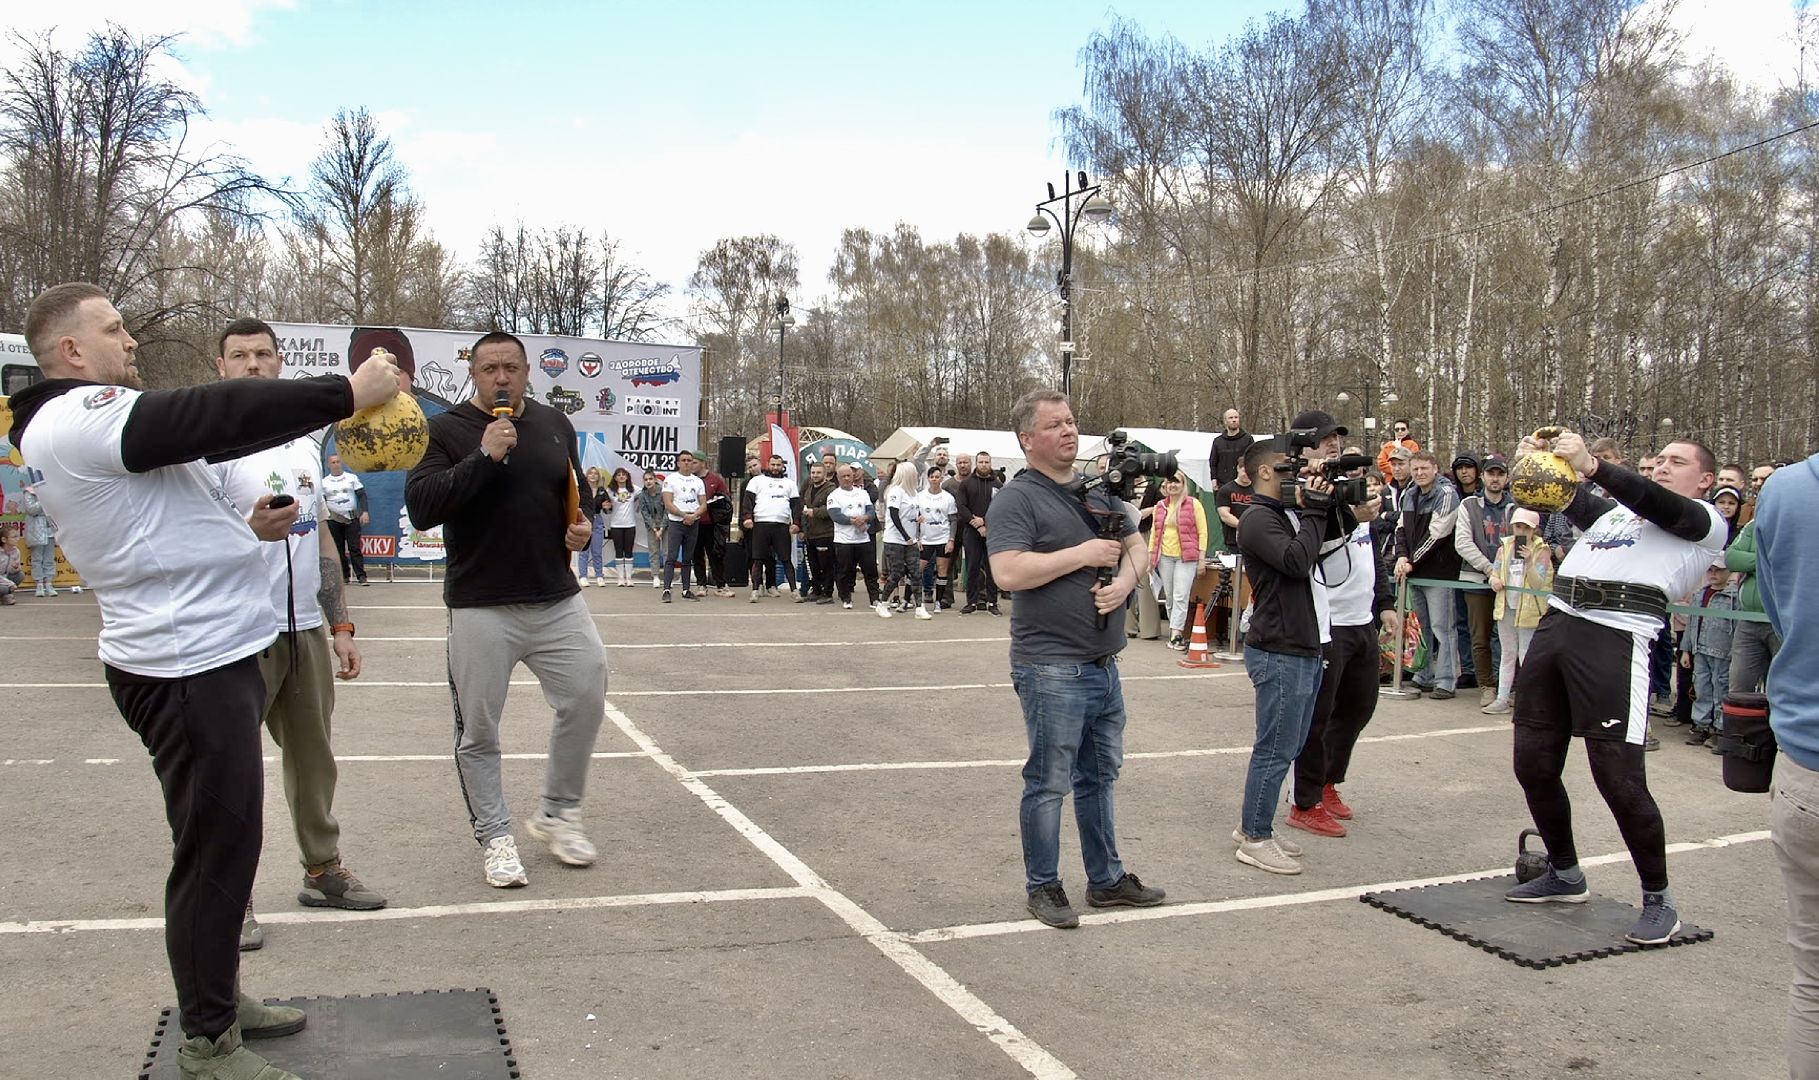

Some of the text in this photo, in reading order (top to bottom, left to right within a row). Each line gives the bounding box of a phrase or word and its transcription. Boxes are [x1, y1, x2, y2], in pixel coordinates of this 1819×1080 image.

[277, 338, 324, 351] ХАИЛ
[279, 352, 340, 366] КЛЯЕВ
[608, 357, 660, 371] ЗДОРОВОЕ
[621, 364, 674, 376] ОТЕЧЕСТВО
[627, 397, 679, 405] TARGET
[622, 424, 678, 452] КЛИН
[805, 452, 818, 464] Я
[1230, 492, 1252, 503] NAS
[361, 538, 392, 555] ЖКУ
